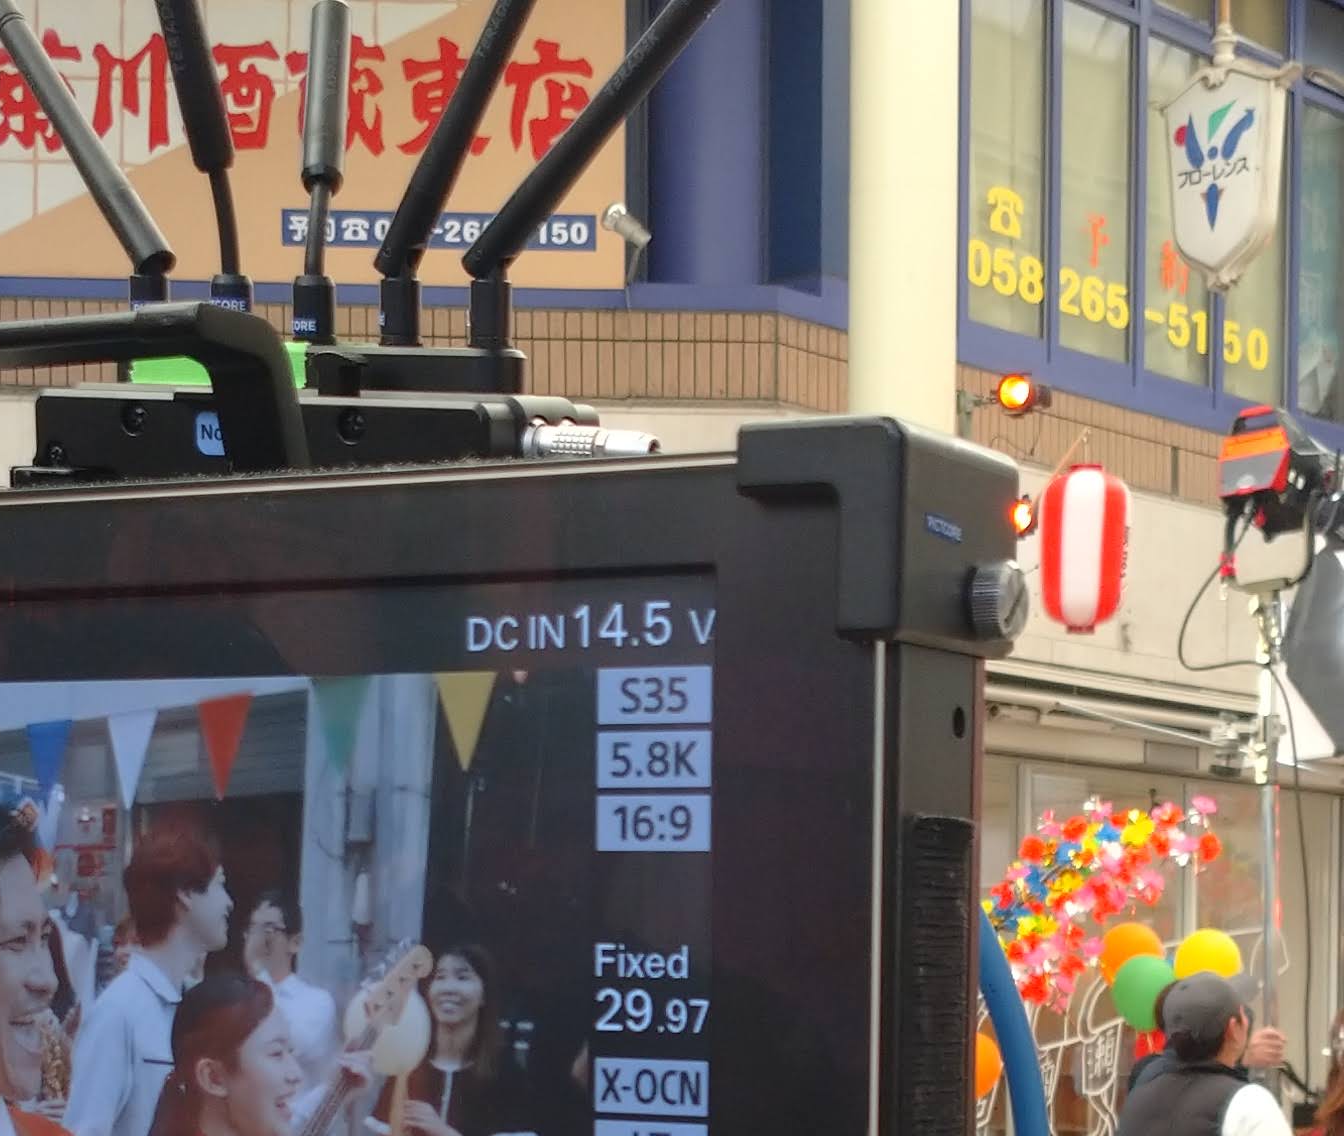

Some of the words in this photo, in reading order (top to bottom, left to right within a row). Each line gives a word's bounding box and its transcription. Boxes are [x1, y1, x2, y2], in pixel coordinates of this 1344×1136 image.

[1177, 157, 1249, 190] フローレンス
[466, 616, 519, 652] DC
[689, 609, 716, 645] V
[619, 676, 688, 714] S35
[610, 740, 697, 778] 5.8K
[614, 804, 692, 841] 16:9
[594, 942, 690, 979] Fixed
[594, 988, 710, 1034] 29.97
[600, 1067, 702, 1107] X-OCN
